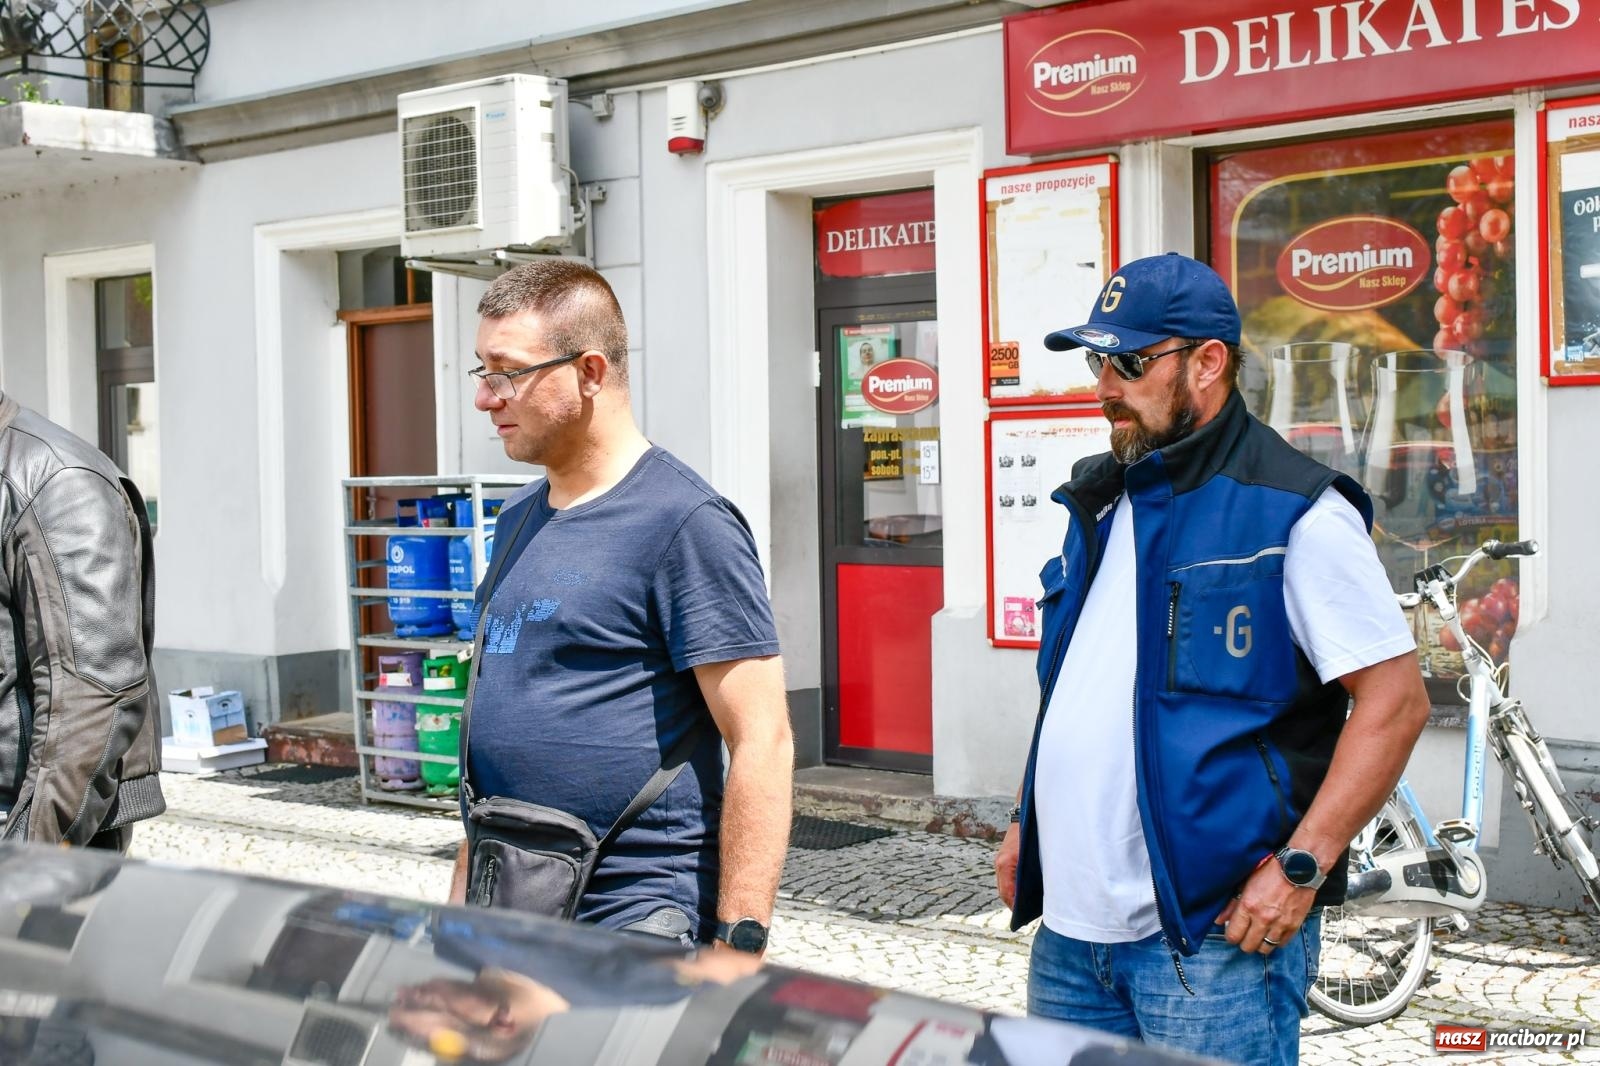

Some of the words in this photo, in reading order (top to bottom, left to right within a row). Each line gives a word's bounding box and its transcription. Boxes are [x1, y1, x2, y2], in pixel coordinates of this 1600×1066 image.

[1033, 54, 1137, 89] Premium
[1001, 182, 1032, 195] nasze
[1035, 173, 1096, 194] propozycje
[1292, 244, 1413, 277] Premium
[1359, 277, 1381, 289] Nasz
[1382, 275, 1407, 288] Sklep
[990, 347, 1020, 361] 2500
[1007, 360, 1020, 369] GB
[868, 374, 933, 393] Premium
[871, 464, 900, 476] sobota
